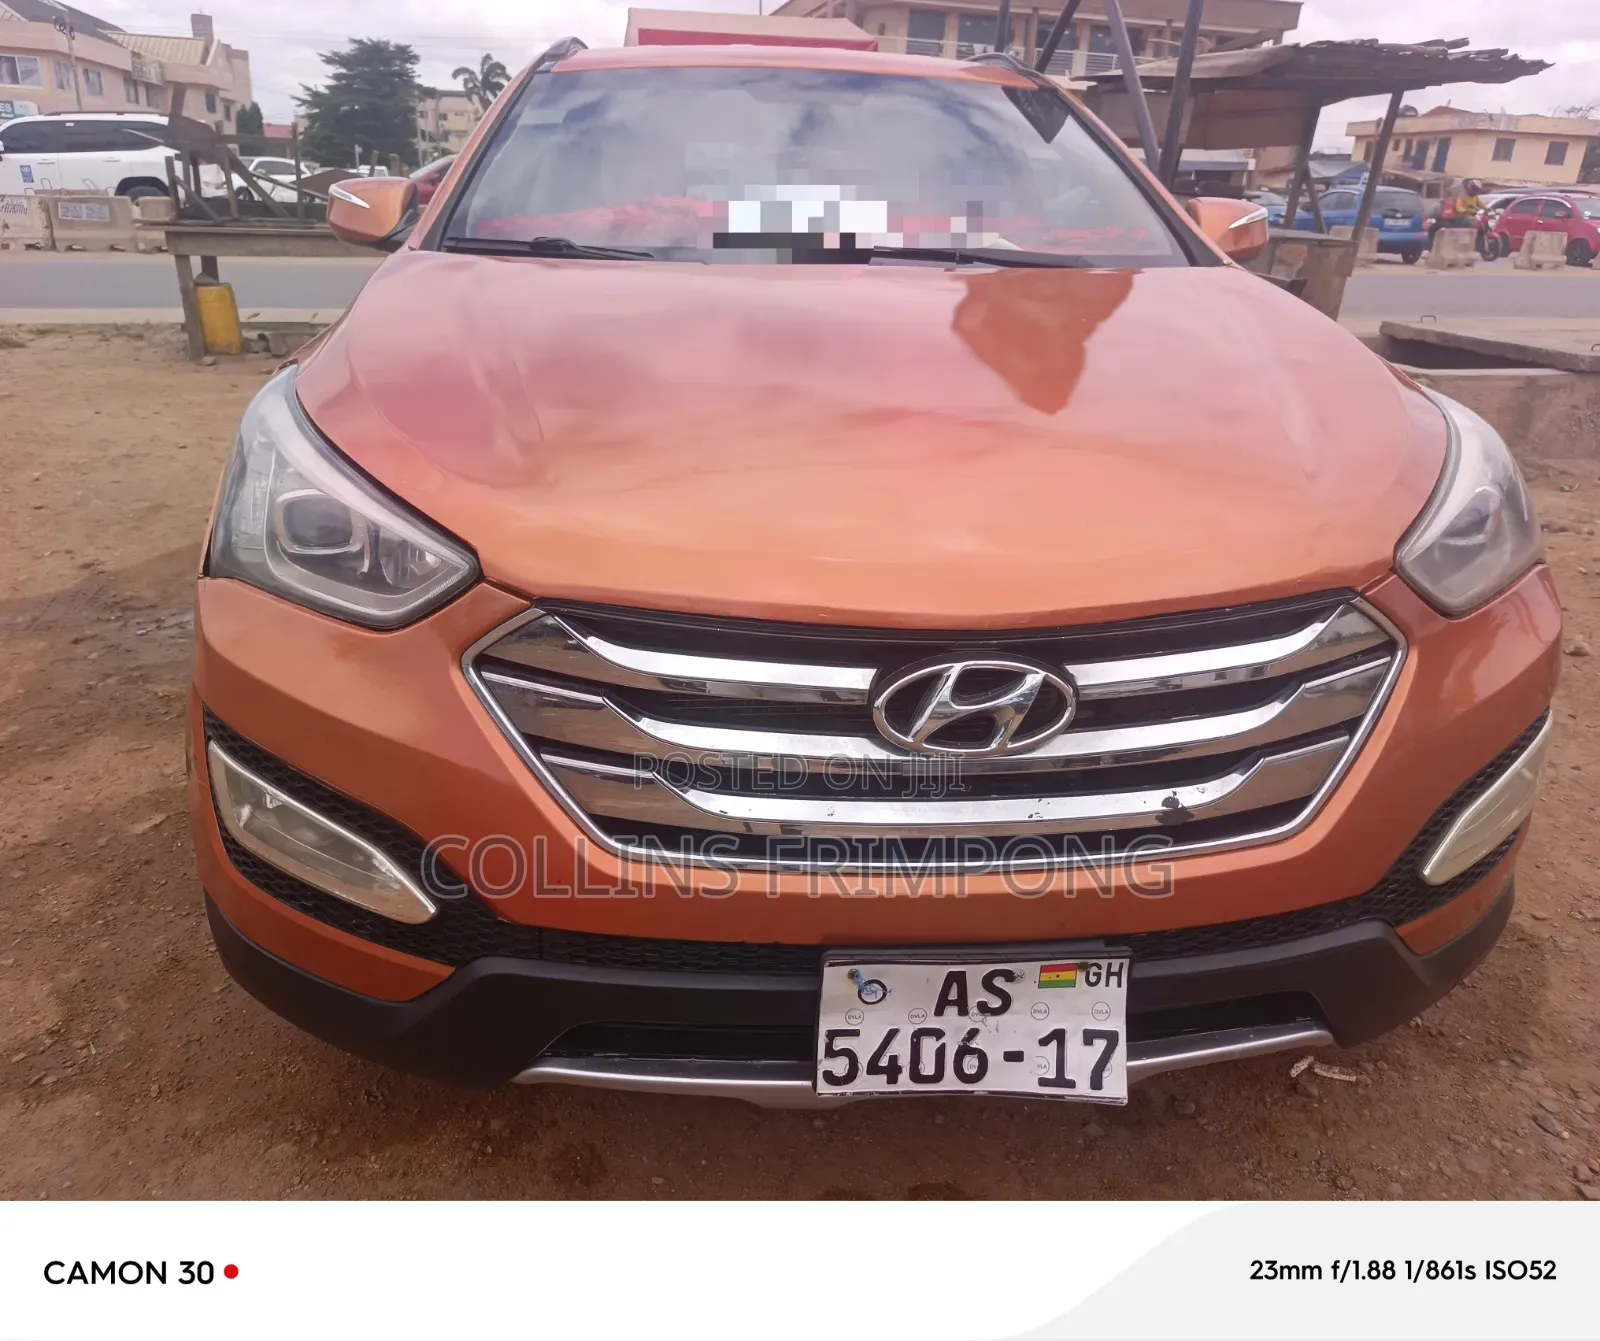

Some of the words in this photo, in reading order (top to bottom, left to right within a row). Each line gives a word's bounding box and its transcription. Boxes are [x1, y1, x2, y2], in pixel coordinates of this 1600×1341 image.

[933, 968, 1015, 1017] AS
[1084, 962, 1124, 988] GH
[822, 1027, 1120, 1090] 5406-17
